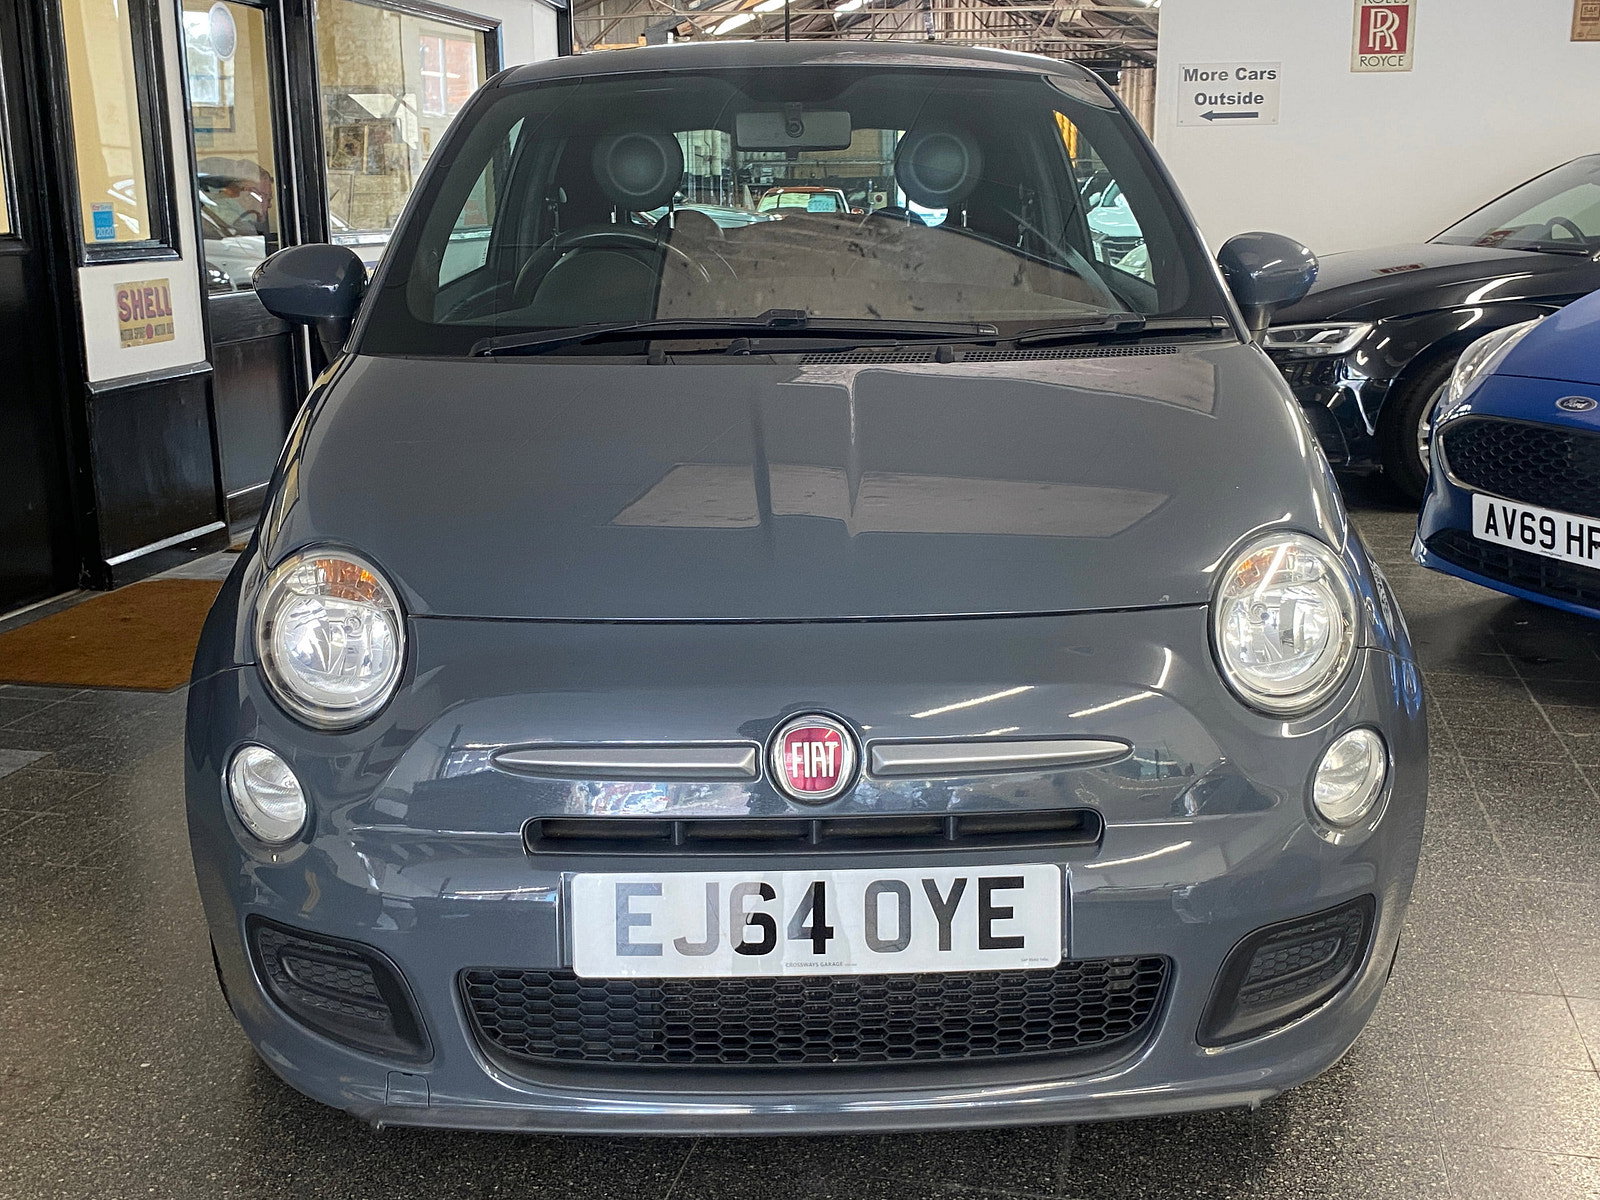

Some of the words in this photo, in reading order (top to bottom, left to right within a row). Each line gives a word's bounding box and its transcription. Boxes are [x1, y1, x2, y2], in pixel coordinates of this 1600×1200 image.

[1183, 68, 1229, 82] More
[1235, 67, 1277, 81] Cars
[1360, 55, 1404, 67] ROYCE
[1194, 91, 1264, 106] Outside
[117, 286, 172, 322] SHELL
[1484, 502, 1556, 551] AV69
[791, 741, 840, 778] FIAT
[615, 880, 834, 957] EJ64
[864, 875, 1025, 953] OYE
